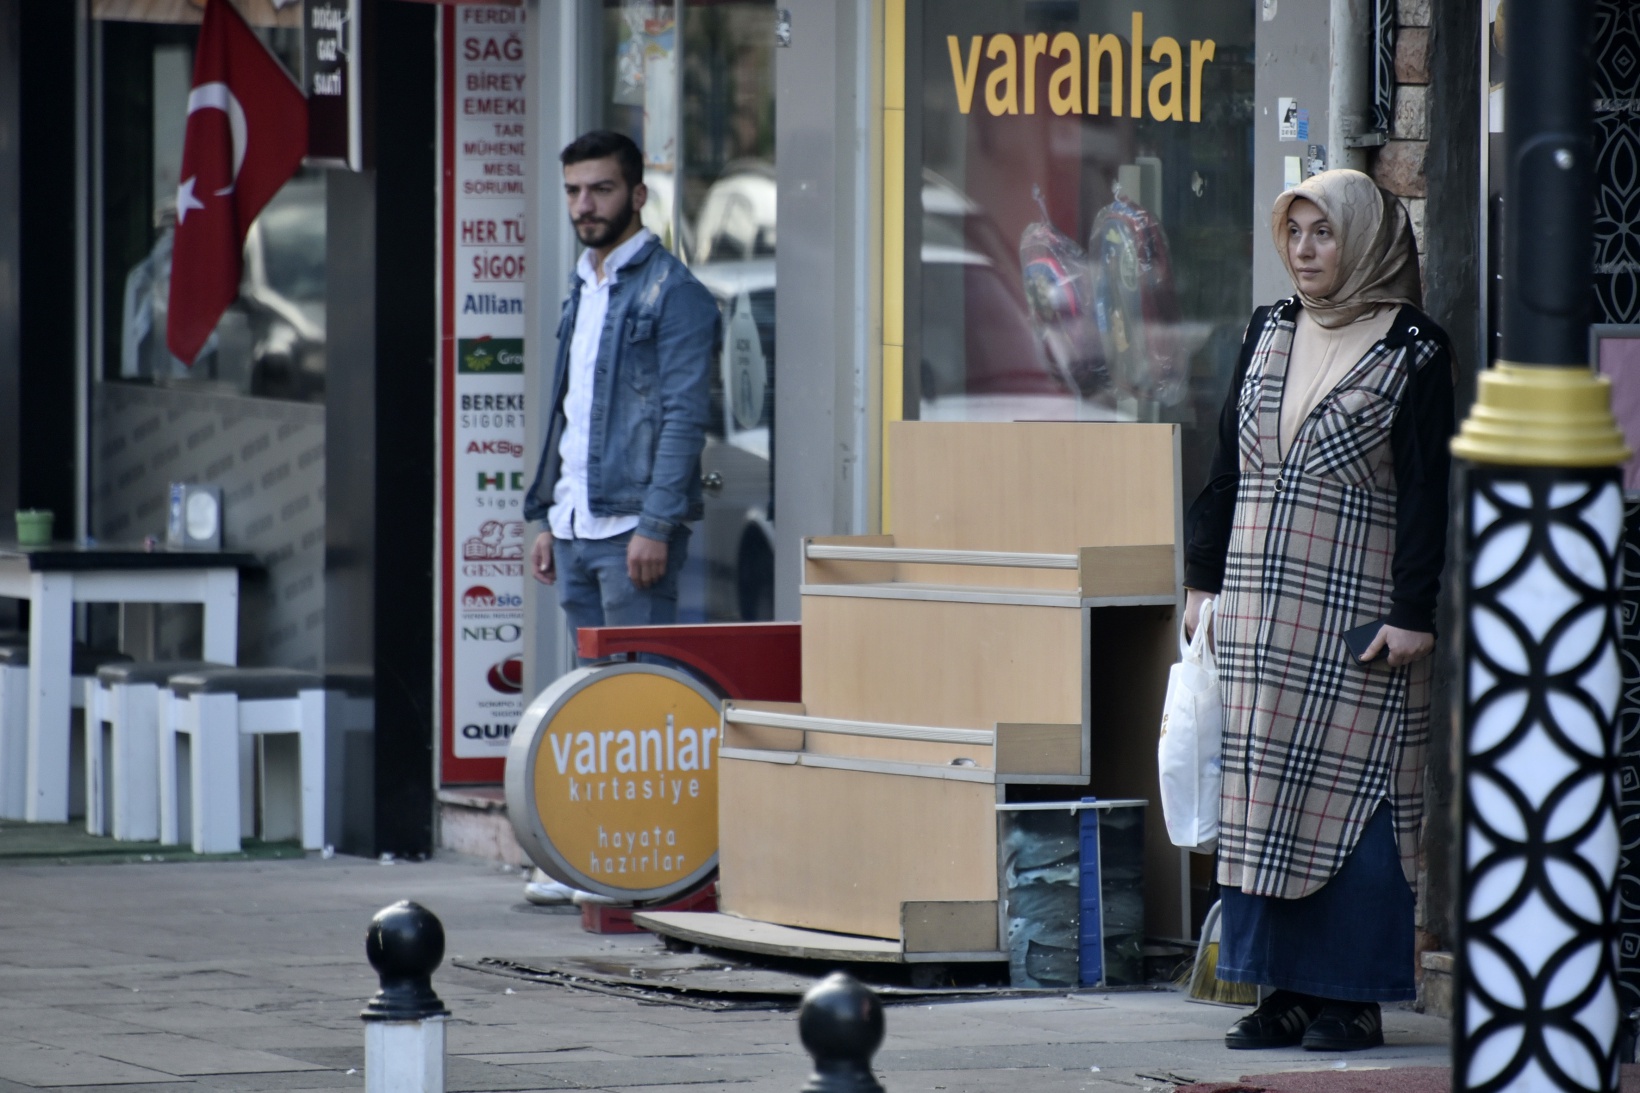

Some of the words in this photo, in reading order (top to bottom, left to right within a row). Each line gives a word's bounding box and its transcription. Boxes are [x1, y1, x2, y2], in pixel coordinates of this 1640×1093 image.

[464, 31, 524, 61] SAĞ
[467, 70, 526, 91] BİREY
[947, 11, 1216, 123] varanlar
[462, 219, 497, 242] HER
[463, 294, 524, 314] Allian
[550, 713, 718, 775] varanlar
[569, 773, 700, 805] kırtasiye
[598, 824, 676, 854] hayata
[590, 848, 685, 874] hazırlar
